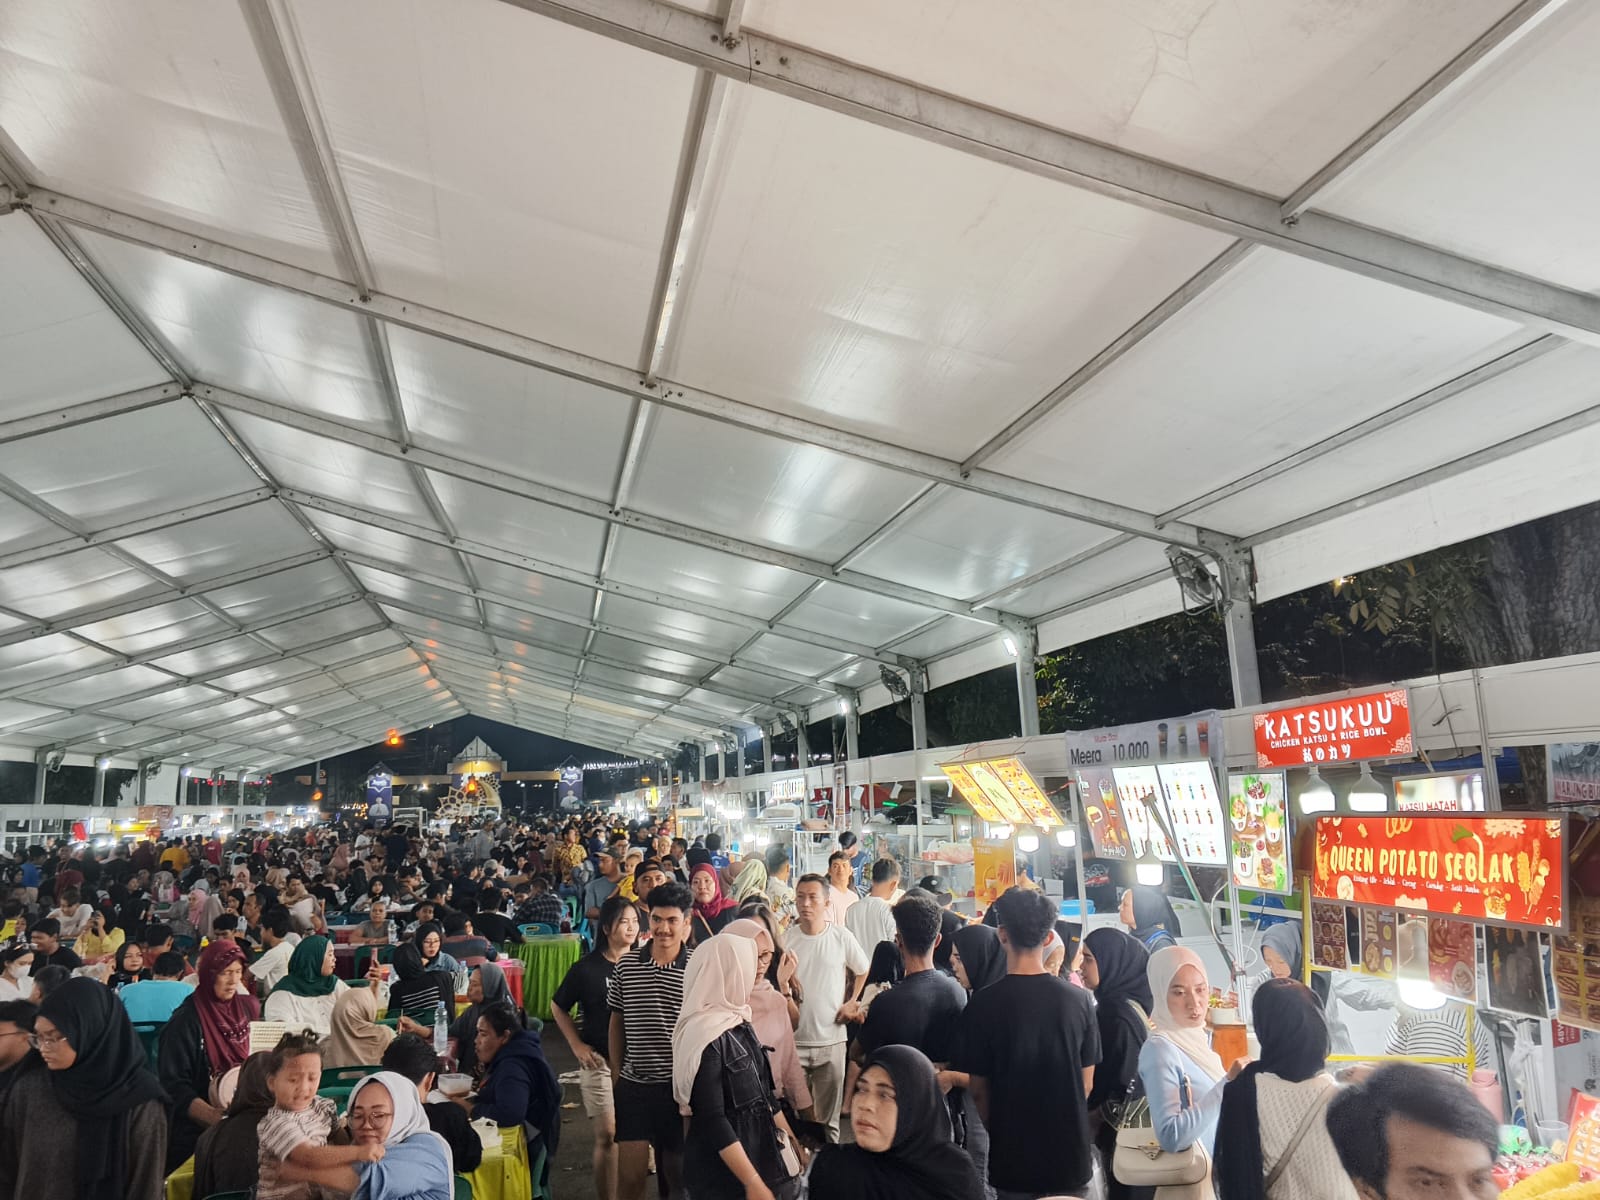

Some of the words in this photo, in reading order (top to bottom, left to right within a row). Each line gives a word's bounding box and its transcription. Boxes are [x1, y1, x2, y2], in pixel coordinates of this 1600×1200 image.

[1264, 700, 1393, 740] KATSUKUU
[1070, 748, 1102, 765] Meera
[1112, 741, 1150, 760] 10.000
[1271, 738, 1300, 749] CHICKEN
[1303, 735, 1328, 745] KATSU
[1340, 729, 1360, 740] RICE
[1363, 727, 1387, 737] BOWL
[1330, 845, 1374, 874] QUEEN
[1379, 849, 1438, 880] POTATO
[1444, 846, 1515, 884] SEBLAK
